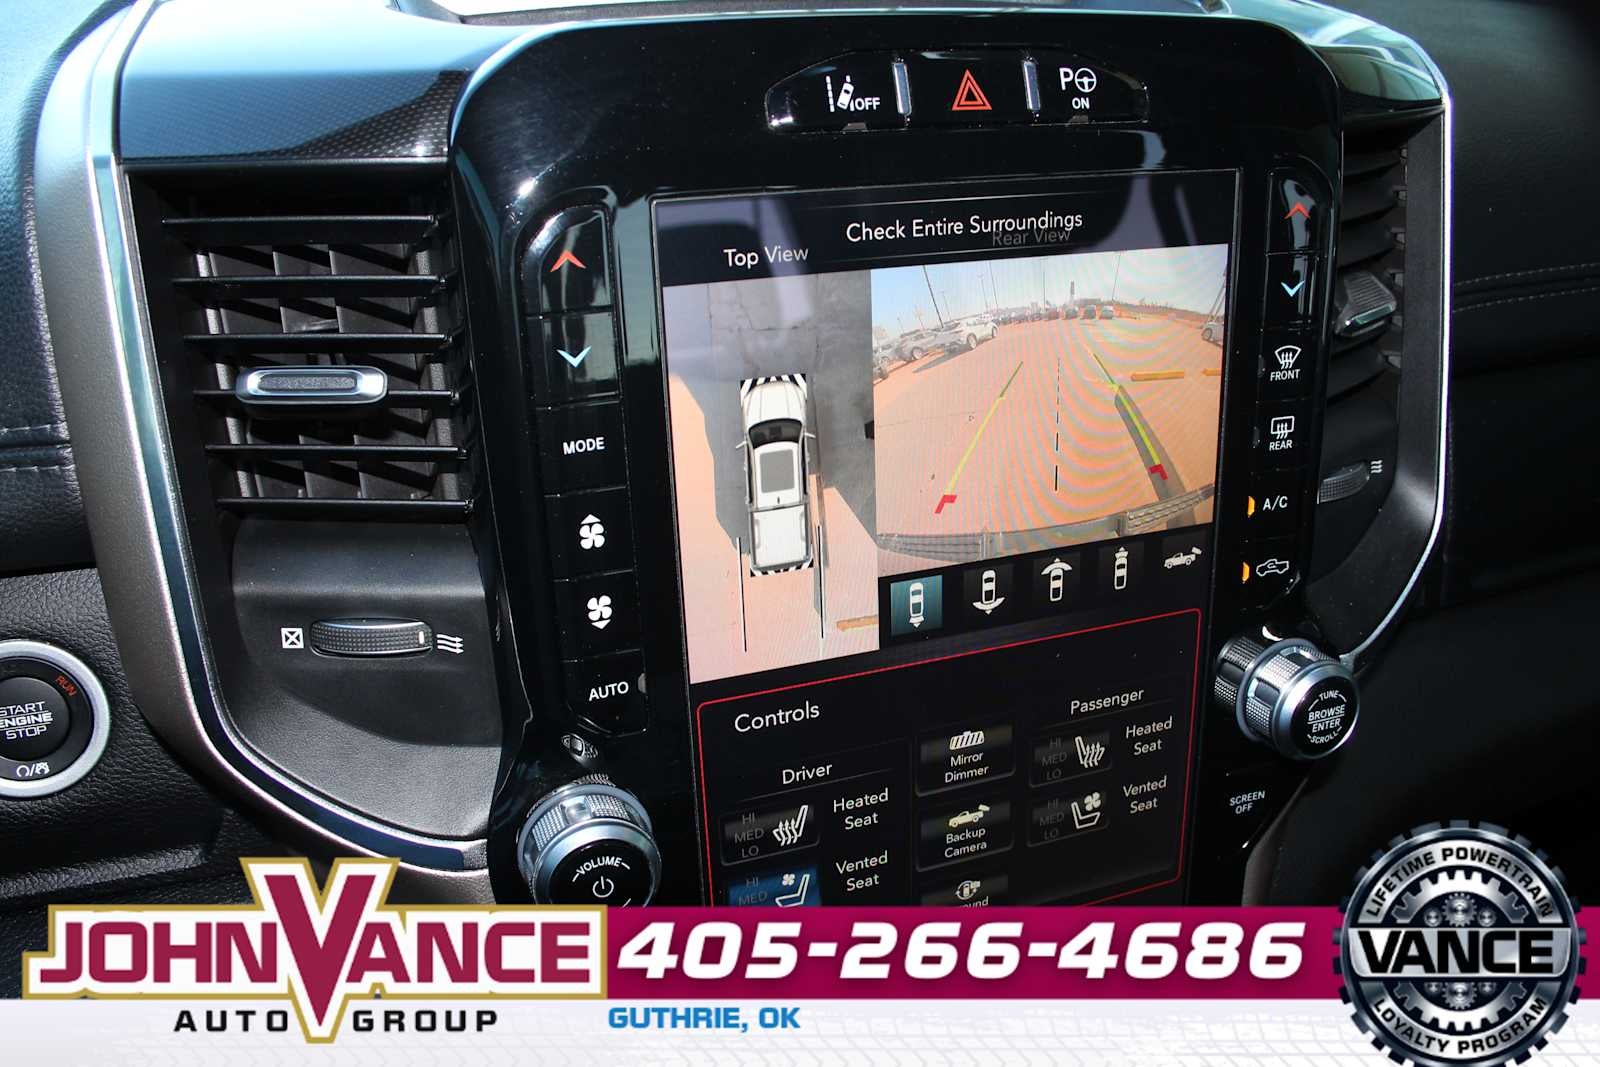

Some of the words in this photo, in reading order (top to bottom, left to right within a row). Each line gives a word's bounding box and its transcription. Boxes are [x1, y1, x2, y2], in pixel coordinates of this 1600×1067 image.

[856, 97, 881, 111] OFF
[1071, 97, 1091, 110] ON
[845, 222, 906, 243] Check
[911, 216, 965, 239] Entire
[969, 210, 1084, 235] Surroundings
[991, 229, 1028, 248] Rear
[1033, 226, 1072, 245] View
[723, 248, 759, 269] Top
[764, 244, 809, 265] View
[1269, 368, 1301, 382] FRONT
[562, 436, 606, 455] MODE
[1268, 439, 1293, 451] REAR
[1262, 495, 1289, 511] A/C
[55, 675, 77, 697] RUN
[588, 681, 630, 702] AUTO
[1319, 689, 1340, 701] TUNE
[1070, 688, 1145, 715] Passenger
[734, 701, 820, 732] Controls
[1308, 703, 1346, 722] BROWSE
[5, 725, 47, 740] STOP
[1125, 715, 1173, 739] Heated
[1311, 718, 1341, 732] ENTER
[1133, 738, 1163, 756] Seat
[1310, 731, 1340, 744] SCROLL
[950, 752, 984, 768] Mirror
[782, 763, 833, 785] Driver
[944, 765, 989, 783] Dimmer
[1122, 775, 1168, 798] Vented
[832, 787, 890, 813] Heated
[1129, 796, 1158, 815] Seat
[1229, 790, 1267, 807] SCREEN
[1235, 803, 1254, 815] OFF
[742, 813, 757, 825] HI
[844, 811, 879, 831] Seat
[733, 827, 765, 844] MED
[945, 826, 987, 845] Backup
[741, 845, 760, 858] LO
[943, 841, 988, 859] Camera
[575, 855, 623, 875] VOLUME
[836, 850, 889, 874] Vented
[846, 873, 880, 892] Seat
